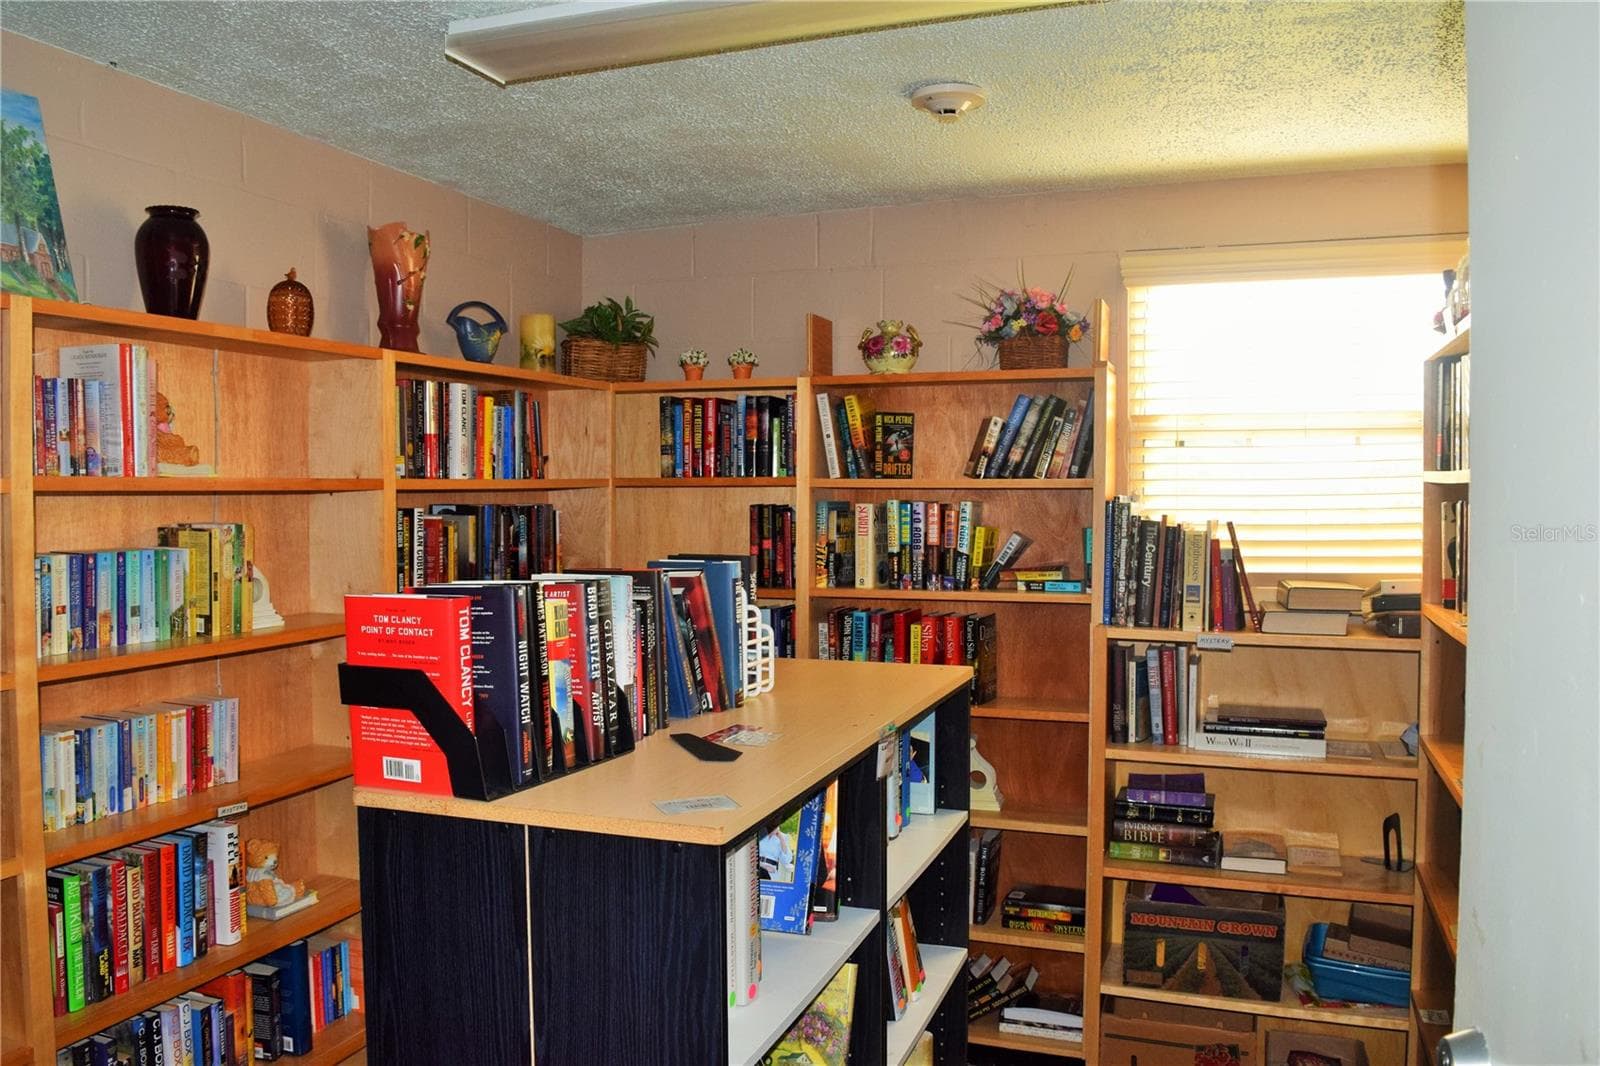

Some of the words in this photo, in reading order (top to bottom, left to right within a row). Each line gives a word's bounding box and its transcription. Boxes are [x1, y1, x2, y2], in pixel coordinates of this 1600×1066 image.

[694, 404, 702, 417] FAYE
[694, 418, 702, 449] KELLERMAN
[883, 463, 912, 475] DRIFTER
[913, 527, 921, 550] ROBB
[1149, 525, 1158, 543] The
[1141, 543, 1156, 588] Century
[536, 588, 547, 621] JAMES
[586, 586, 598, 620] BRAD
[361, 625, 383, 634] POINT
[386, 626, 395, 635] OF
[398, 627, 434, 637] CONTACT
[373, 614, 388, 623] TOM
[391, 615, 422, 624] CLANCY
[458, 606, 471, 640] TOM
[844, 615, 853, 631] JOHN
[946, 620, 954, 640] Daniel
[966, 620, 974, 641] Daniel
[538, 622, 549, 676] PATTERSON
[854, 621, 864, 652] SANDFORD
[921, 622, 933, 652] Silva
[946, 640, 954, 659] Silva
[966, 641, 974, 660] Silva
[517, 640, 530, 678] NIGHT
[588, 624, 601, 680] MELTZER
[459, 645, 474, 708] CLANCY
[604, 618, 618, 723] GIBRALTAR
[519, 682, 531, 724] WATCH
[591, 691, 601, 729] ARTIST
[1245, 738, 1251, 748] II
[1123, 821, 1166, 832] EVIDENCE
[1124, 830, 1165, 844] BIBLE
[182, 844, 191, 879] DAVID
[227, 832, 236, 864] BELL
[68, 881, 77, 901] ACE
[118, 866, 126, 897] DAVID
[69, 903, 81, 943] ATKINS
[183, 882, 193, 935] BALDACCI
[229, 892, 241, 934] WARRIORS
[119, 899, 129, 959] BALDACCI
[132, 900, 142, 948] BALDACCI
[1130, 912, 1214, 932] MOUNTAIN
[1217, 921, 1278, 937] GROWN
[74, 946, 82, 961] THE
[132, 949, 140, 968] MAN
[151, 937, 160, 966] TARGET
[183, 937, 193, 956] FIX
[184, 1029, 193, 1055] BOX
